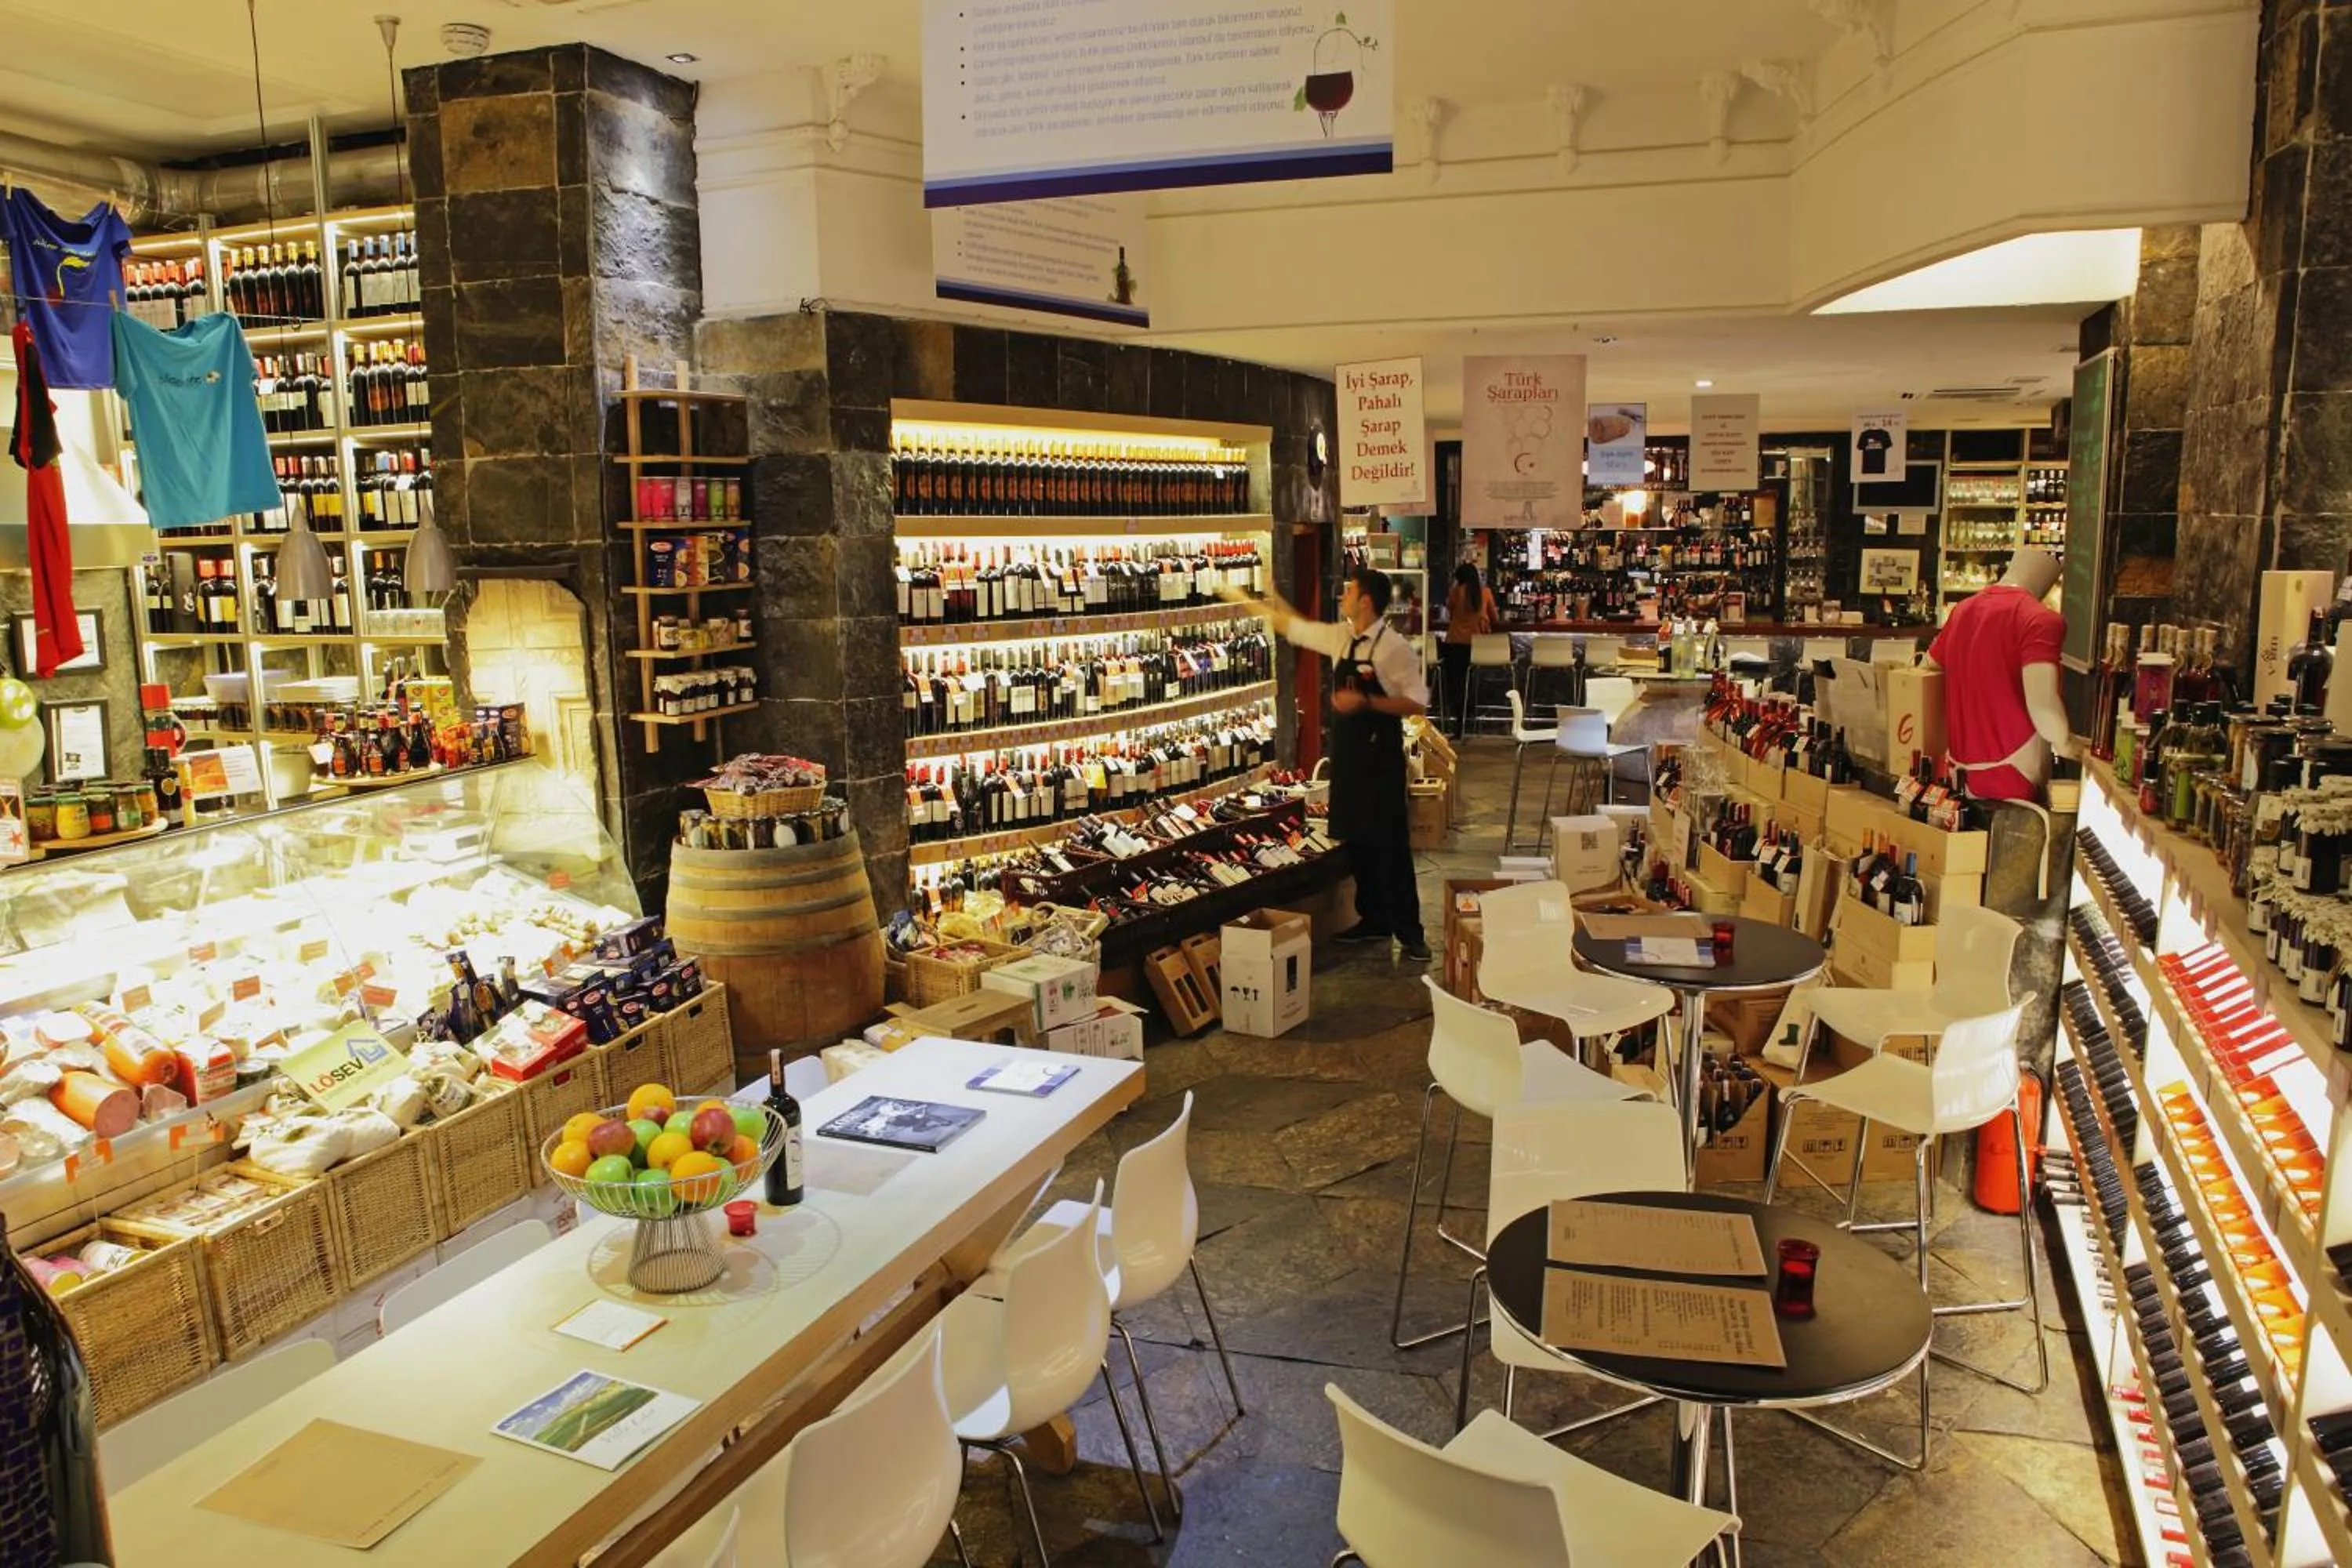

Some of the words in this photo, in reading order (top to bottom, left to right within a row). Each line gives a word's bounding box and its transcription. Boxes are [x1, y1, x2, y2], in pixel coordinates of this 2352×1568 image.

[1345, 371, 1365, 394] İyi
[1369, 372, 1414, 390] Şarap,
[1358, 393, 1402, 412] Pahalı
[1360, 419, 1402, 438] Şarap
[1356, 440, 1407, 457] Demek
[1351, 462, 1416, 484] Değildir!
[309, 1056, 365, 1094] LÖSEV
